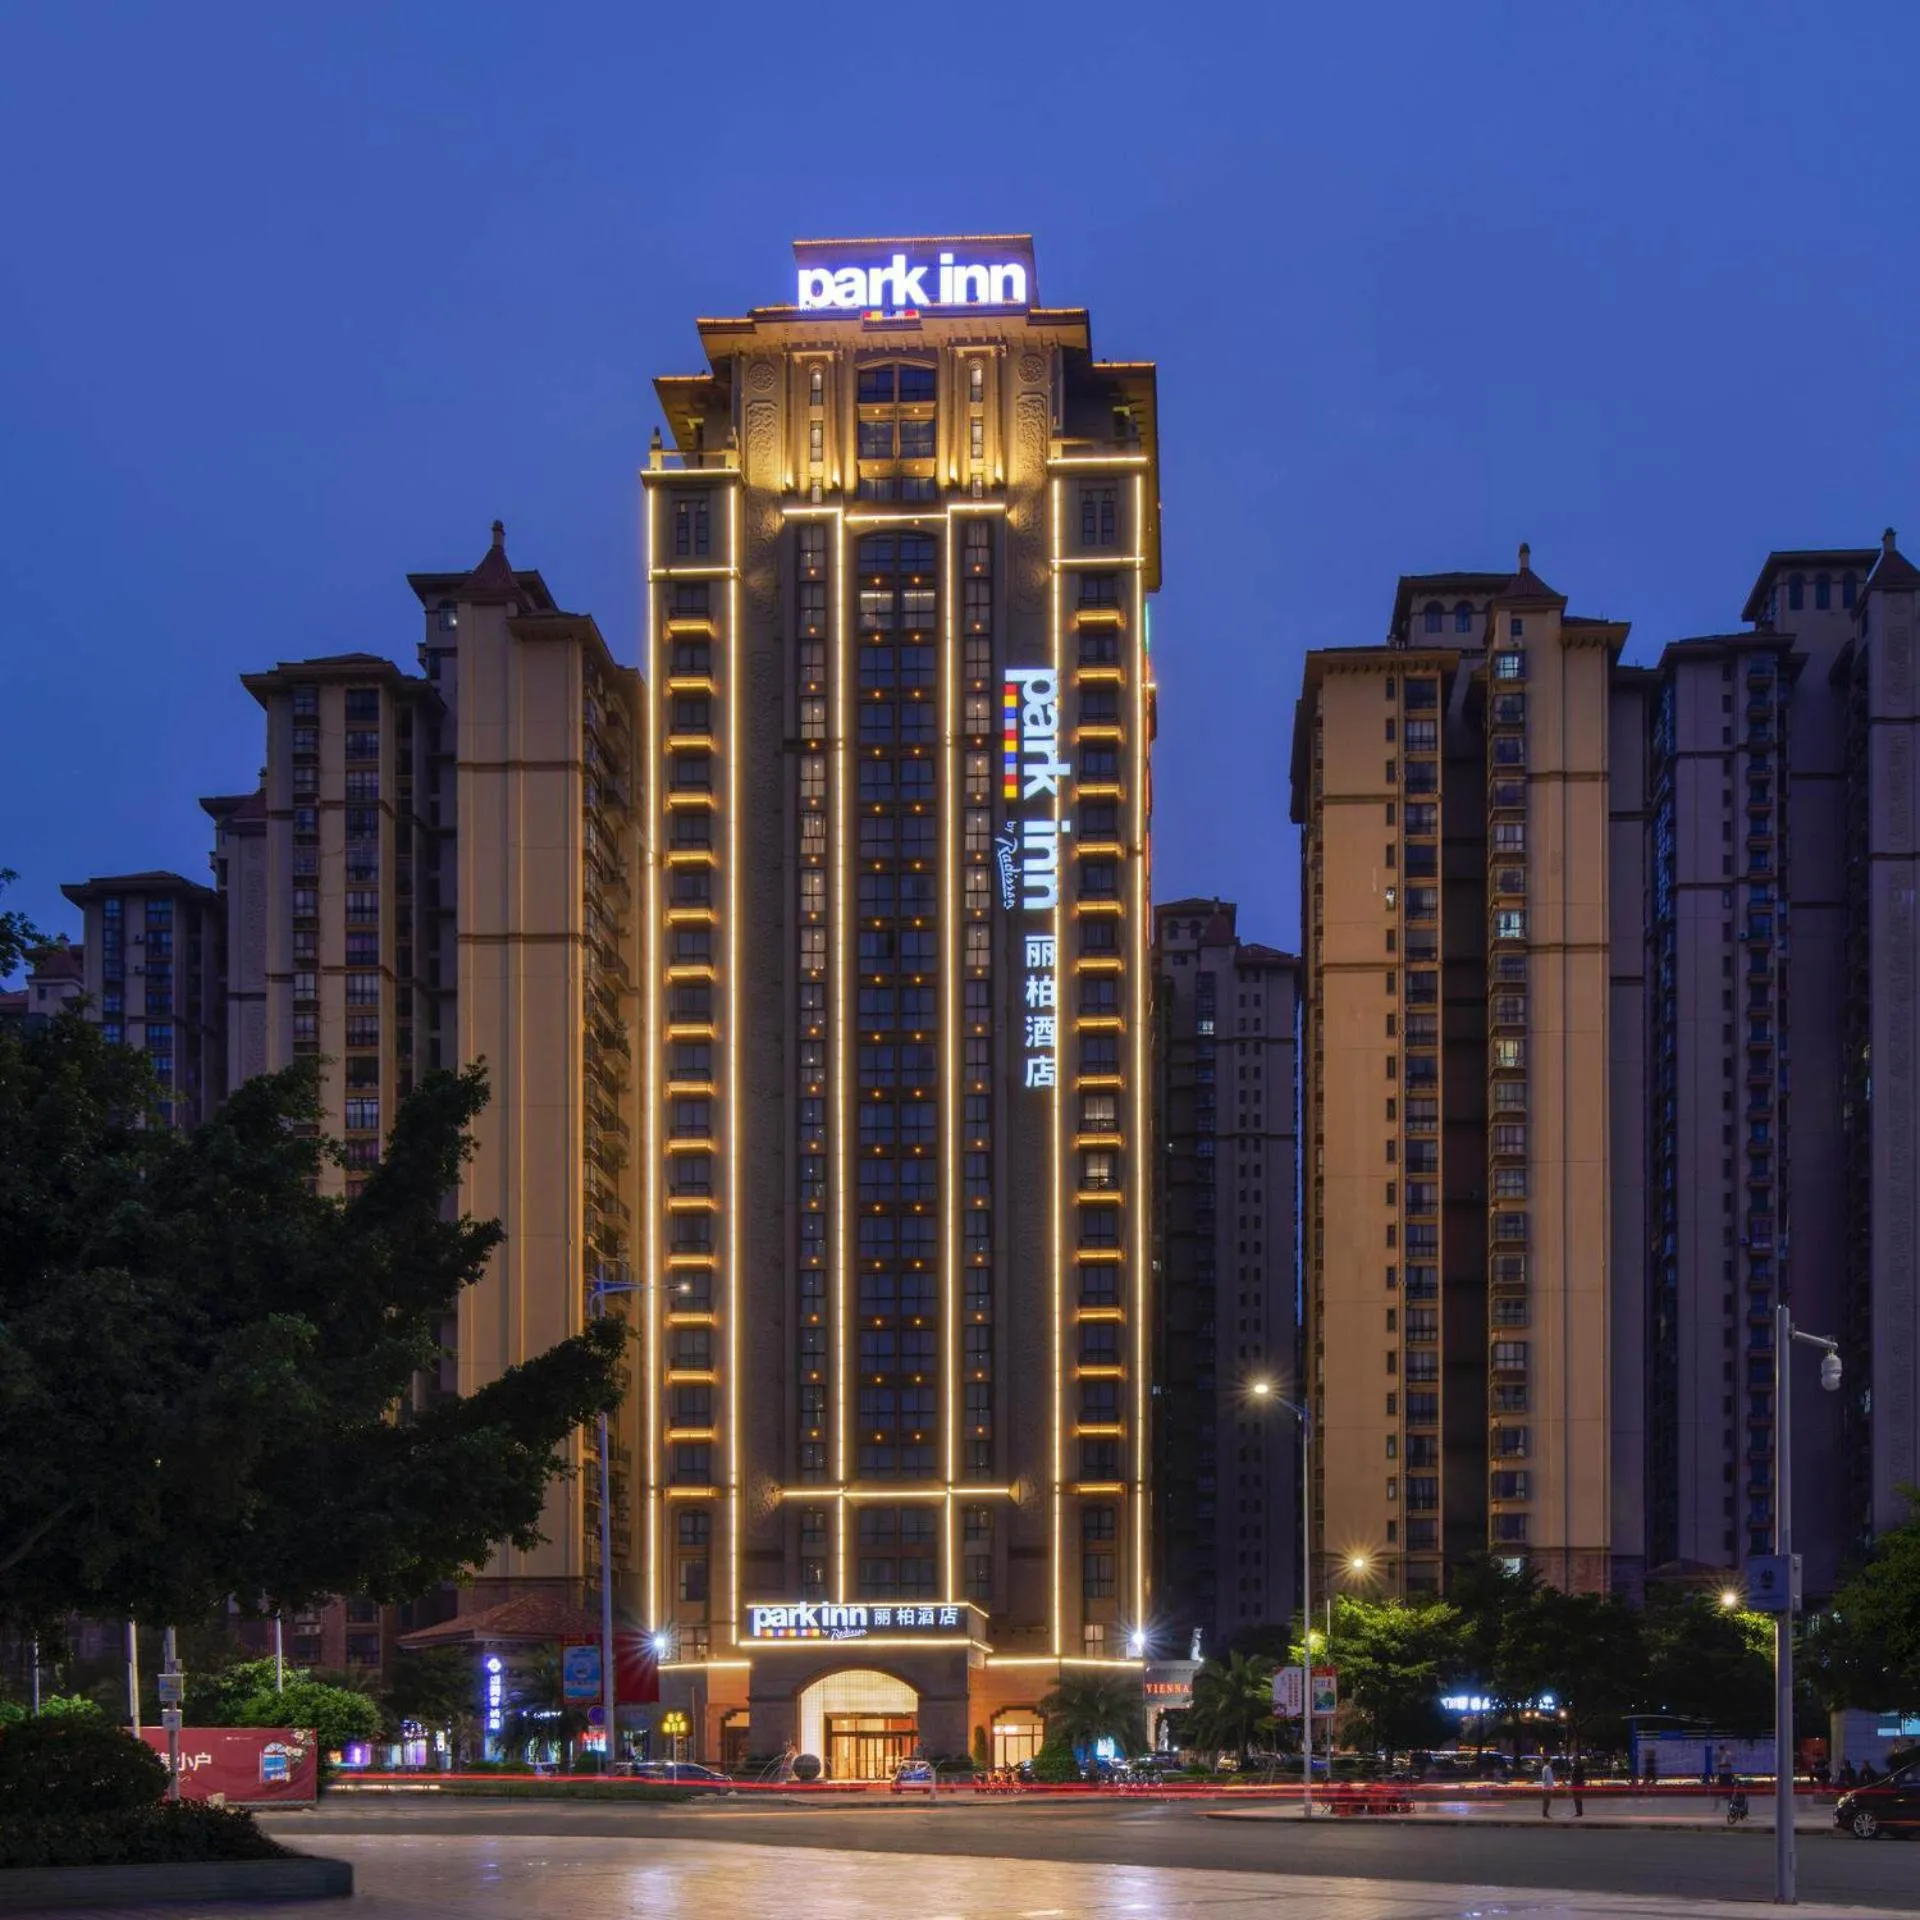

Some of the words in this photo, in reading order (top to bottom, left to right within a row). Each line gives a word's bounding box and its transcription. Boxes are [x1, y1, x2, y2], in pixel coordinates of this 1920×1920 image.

[798, 253, 931, 309] park
[939, 252, 1027, 304] inn
[1004, 668, 1073, 801] park
[1005, 820, 1017, 833] by
[994, 836, 1022, 910] Radisson
[1023, 820, 1071, 910] inn
[1025, 934, 1058, 1089] 丽柏酒店
[753, 1601, 819, 1637] park
[821, 1601, 868, 1627] inn
[873, 1607, 958, 1626] 丽柏酒店
[1145, 1683, 1190, 1695] VIENNA
